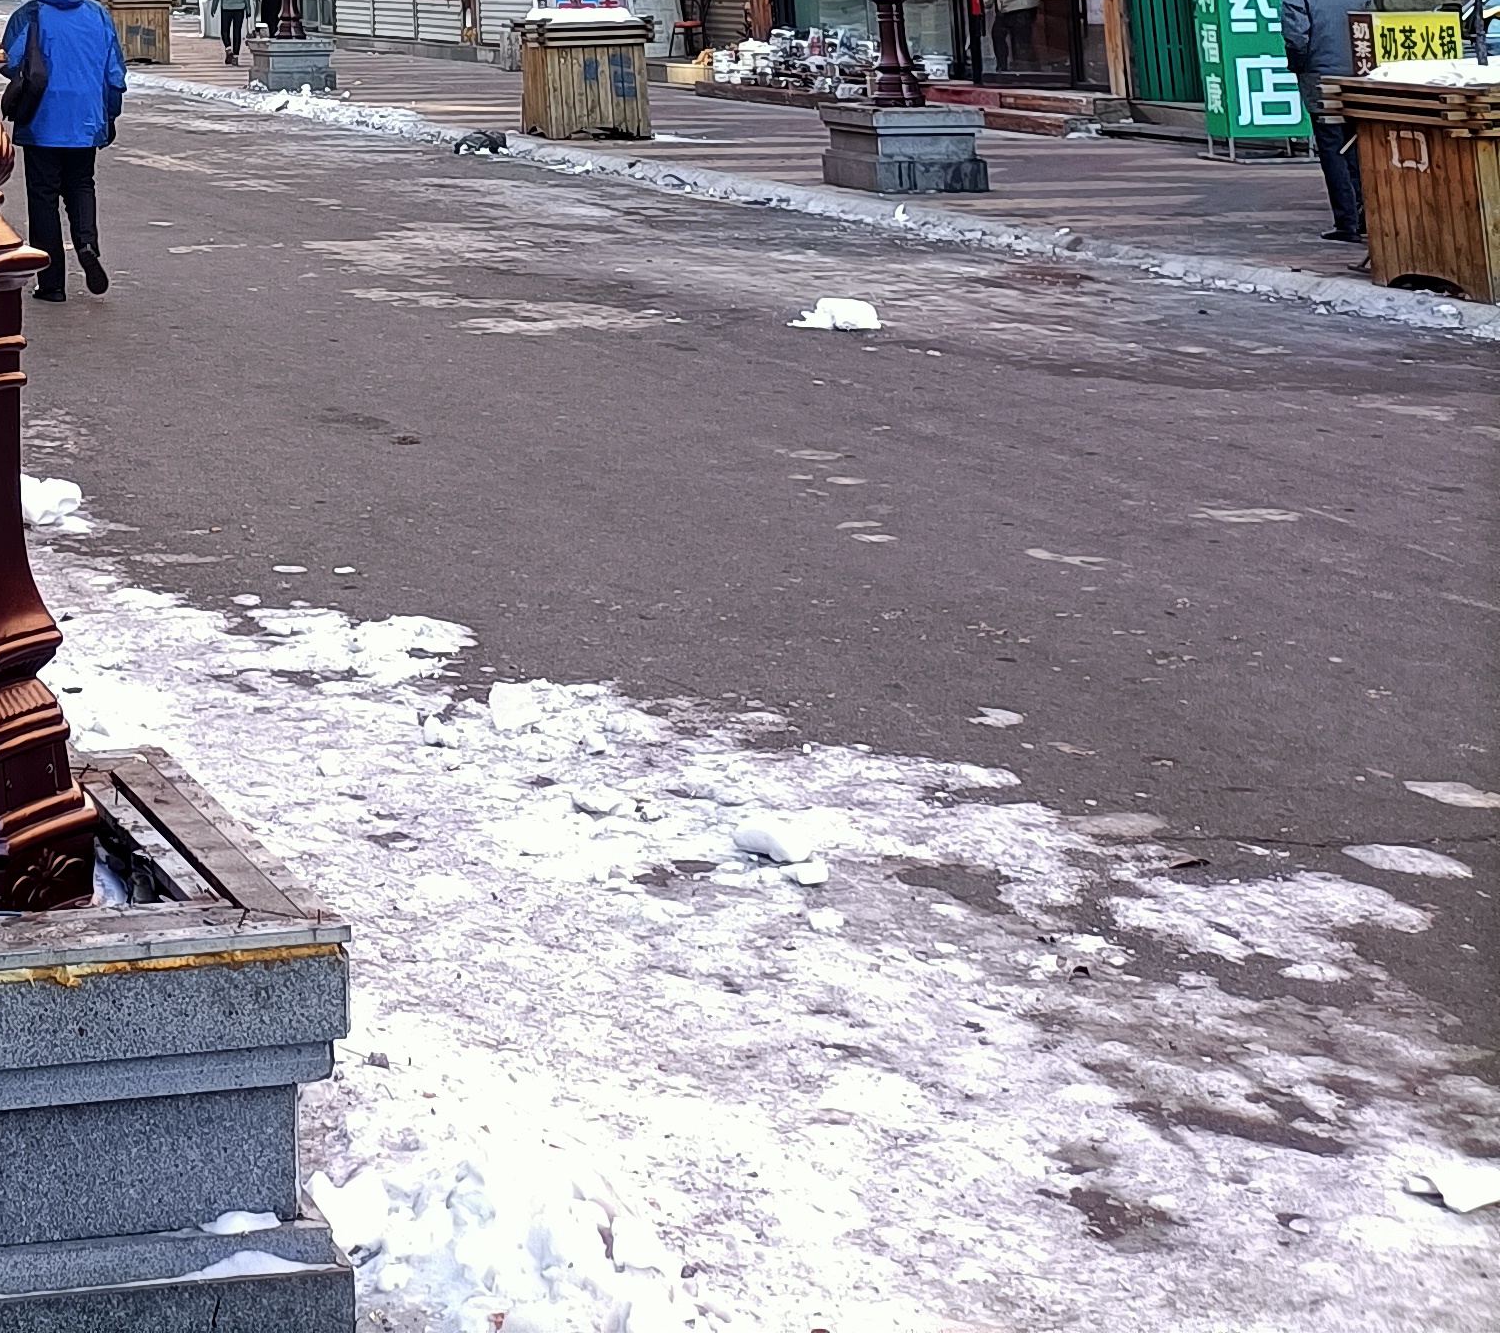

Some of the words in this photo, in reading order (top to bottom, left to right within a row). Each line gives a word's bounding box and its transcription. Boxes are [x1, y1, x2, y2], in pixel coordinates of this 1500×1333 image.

[1351, 21, 1372, 76] 奶茶火
[1379, 24, 1458, 61] 奶茶火锅
